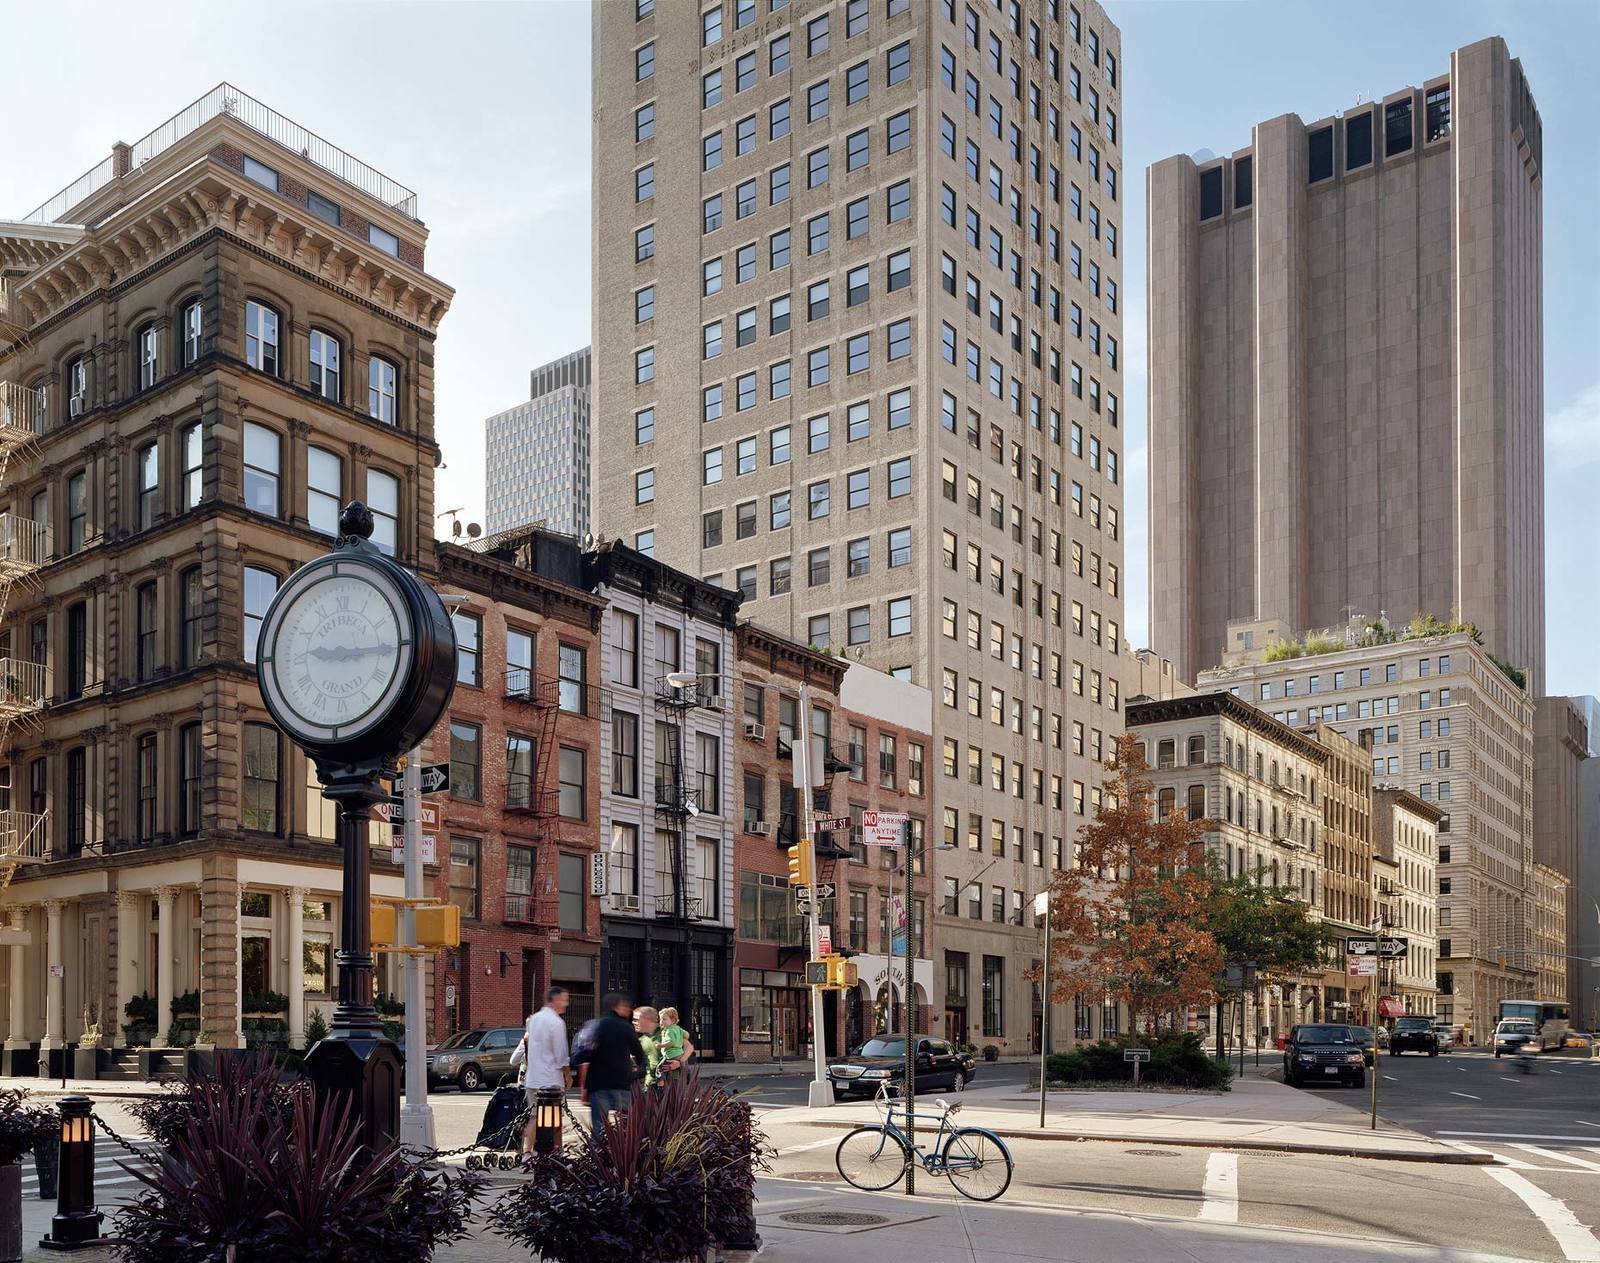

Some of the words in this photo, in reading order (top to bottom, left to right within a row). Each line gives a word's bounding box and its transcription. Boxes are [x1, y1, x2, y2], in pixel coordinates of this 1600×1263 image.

[318, 615, 367, 638] TRIBECA
[322, 675, 362, 694] GRAND
[422, 773, 441, 786] WAY
[381, 804, 401, 817] ONE
[820, 821, 837, 831] WHITE
[839, 819, 847, 829] ST
[864, 813, 876, 825] NO
[878, 817, 907, 825] PARKING
[871, 828, 901, 836] ANYTIME
[394, 837, 404, 847] NO
[1381, 943, 1400, 951] WAY
